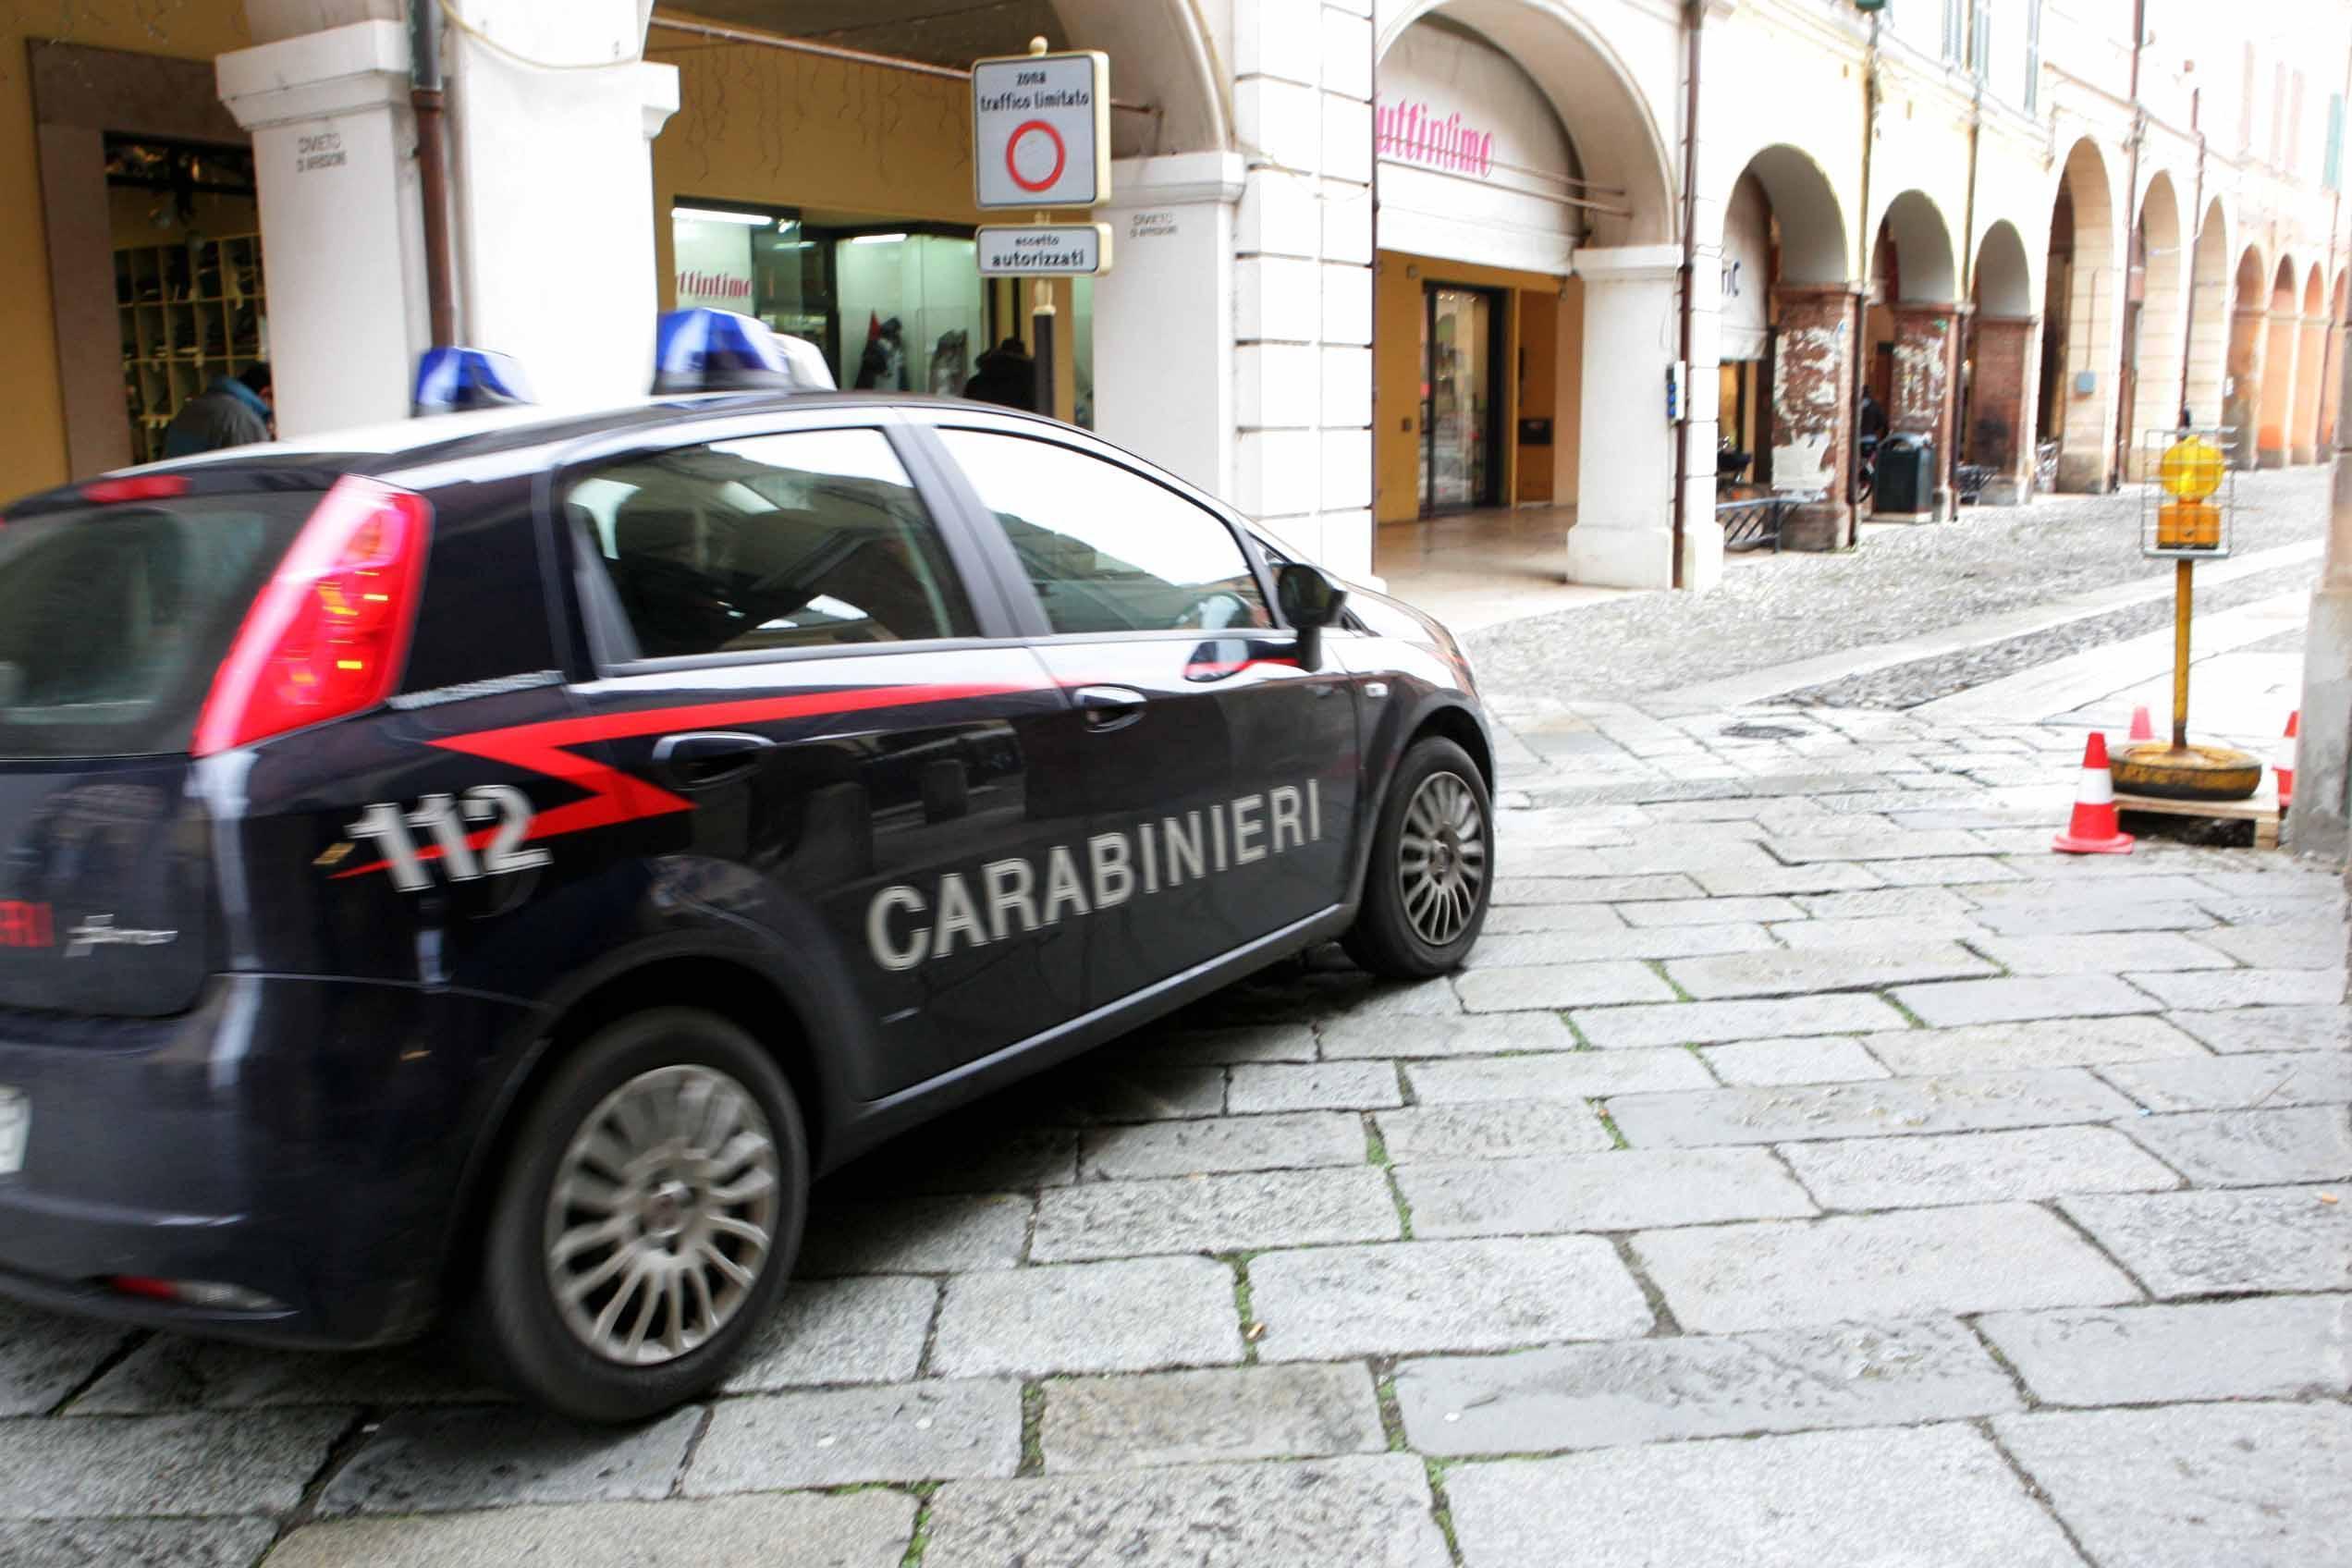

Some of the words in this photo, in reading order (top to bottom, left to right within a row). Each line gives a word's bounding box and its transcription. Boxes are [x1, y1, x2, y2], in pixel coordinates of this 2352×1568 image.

[1016, 71, 1047, 85] zona
[980, 92, 1031, 112] traffico
[1034, 88, 1090, 109] limitato
[1376, 91, 1495, 178] uttintimo
[1015, 233, 1060, 247] eccetto
[991, 248, 1085, 267] autorizzati
[674, 270, 752, 300] ttintimo
[343, 784, 555, 894] 112
[866, 778, 1322, 972] CARABINIERI
